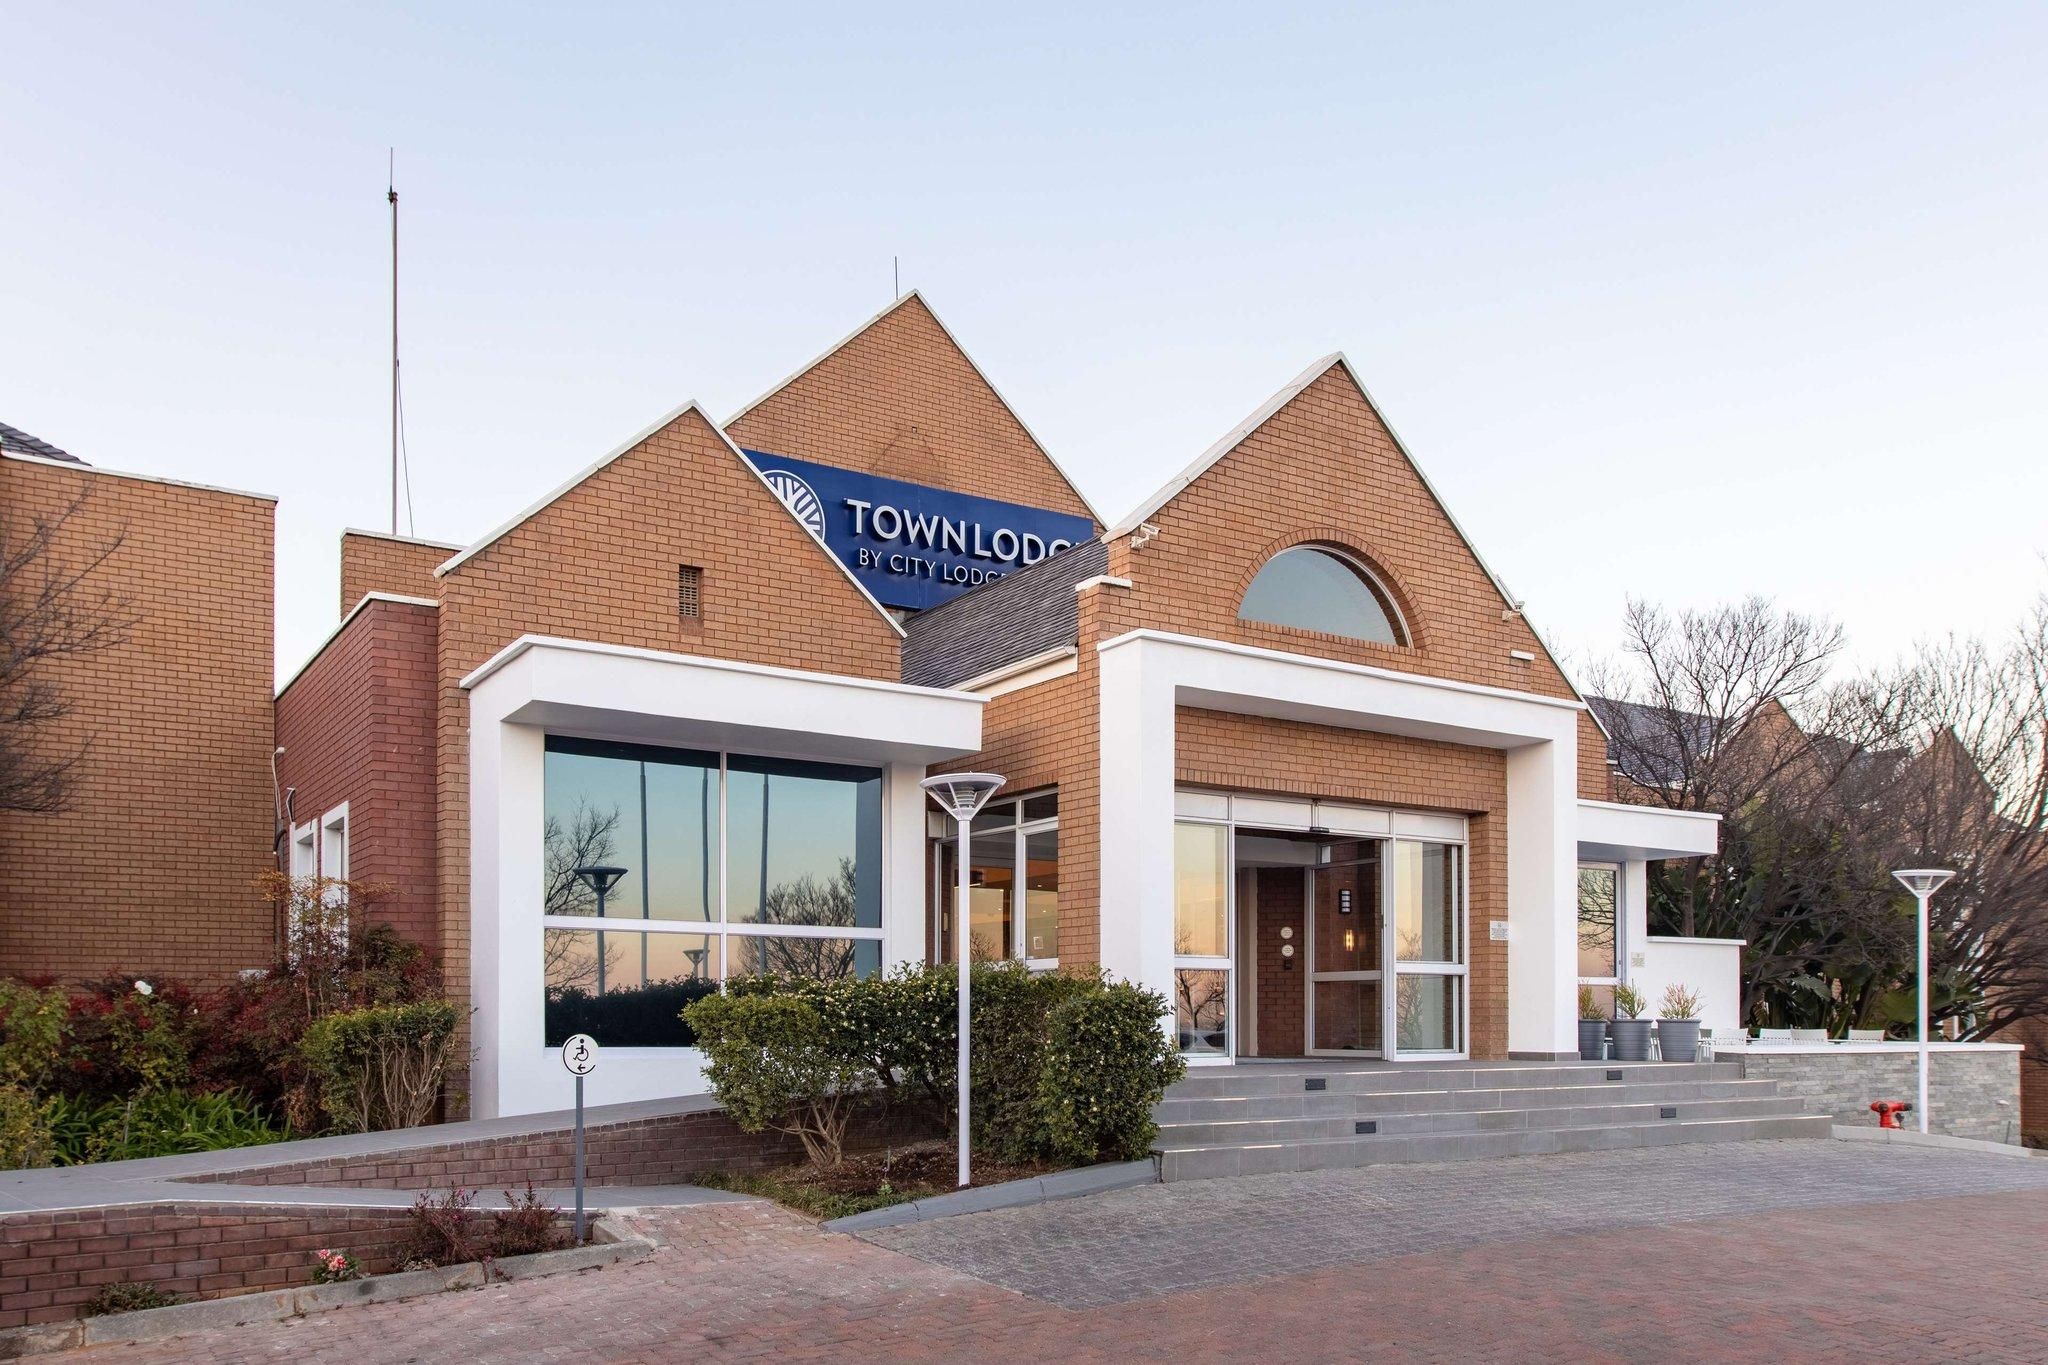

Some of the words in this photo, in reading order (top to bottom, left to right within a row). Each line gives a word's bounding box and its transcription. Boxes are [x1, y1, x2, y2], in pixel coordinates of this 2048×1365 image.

[847, 498, 1080, 565] TOWNLOD
[860, 547, 882, 568] BY
[890, 554, 936, 577] CITY
[944, 563, 1006, 585] LODG
